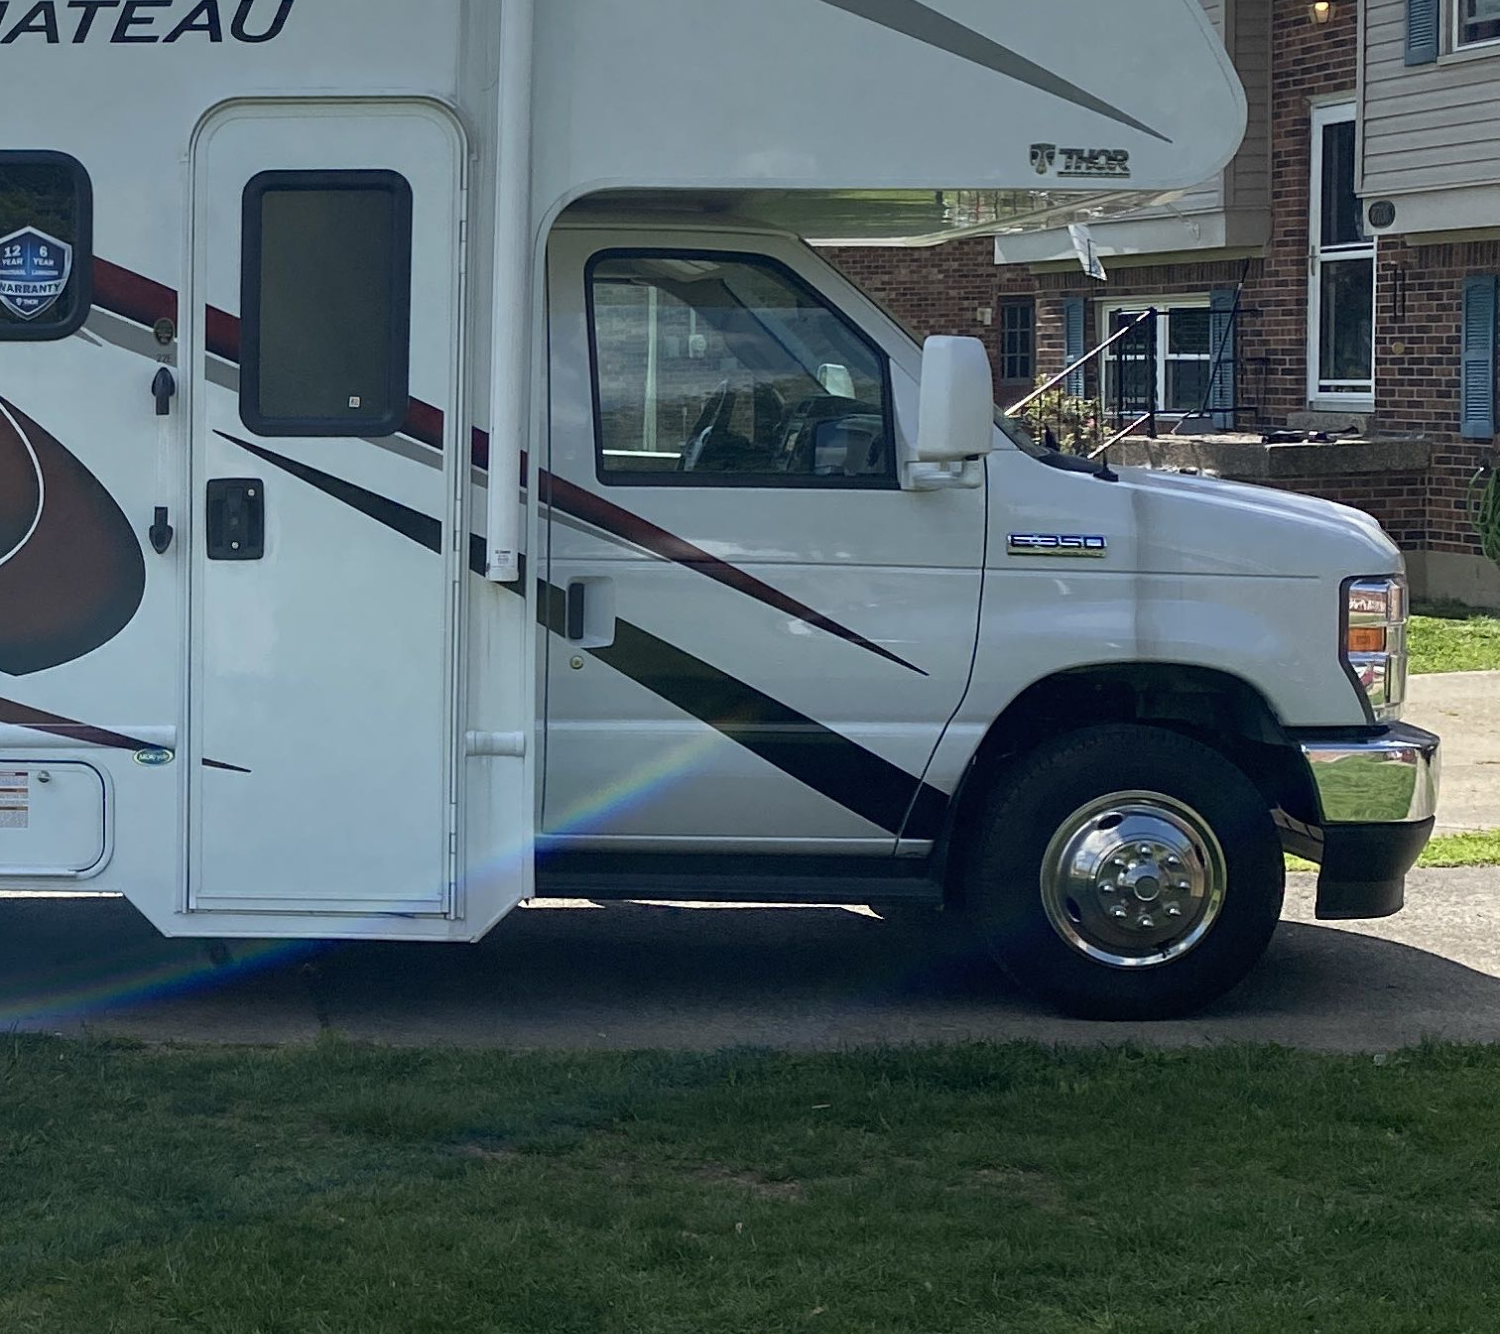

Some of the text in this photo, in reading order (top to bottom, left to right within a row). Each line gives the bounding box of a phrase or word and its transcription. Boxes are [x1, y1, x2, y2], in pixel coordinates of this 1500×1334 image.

[1058, 148, 1131, 172] THOR
[4, 244, 21, 258] 12
[39, 245, 48, 257] 6
[2, 258, 24, 266] YEAR
[33, 258, 55, 266] YEAR
